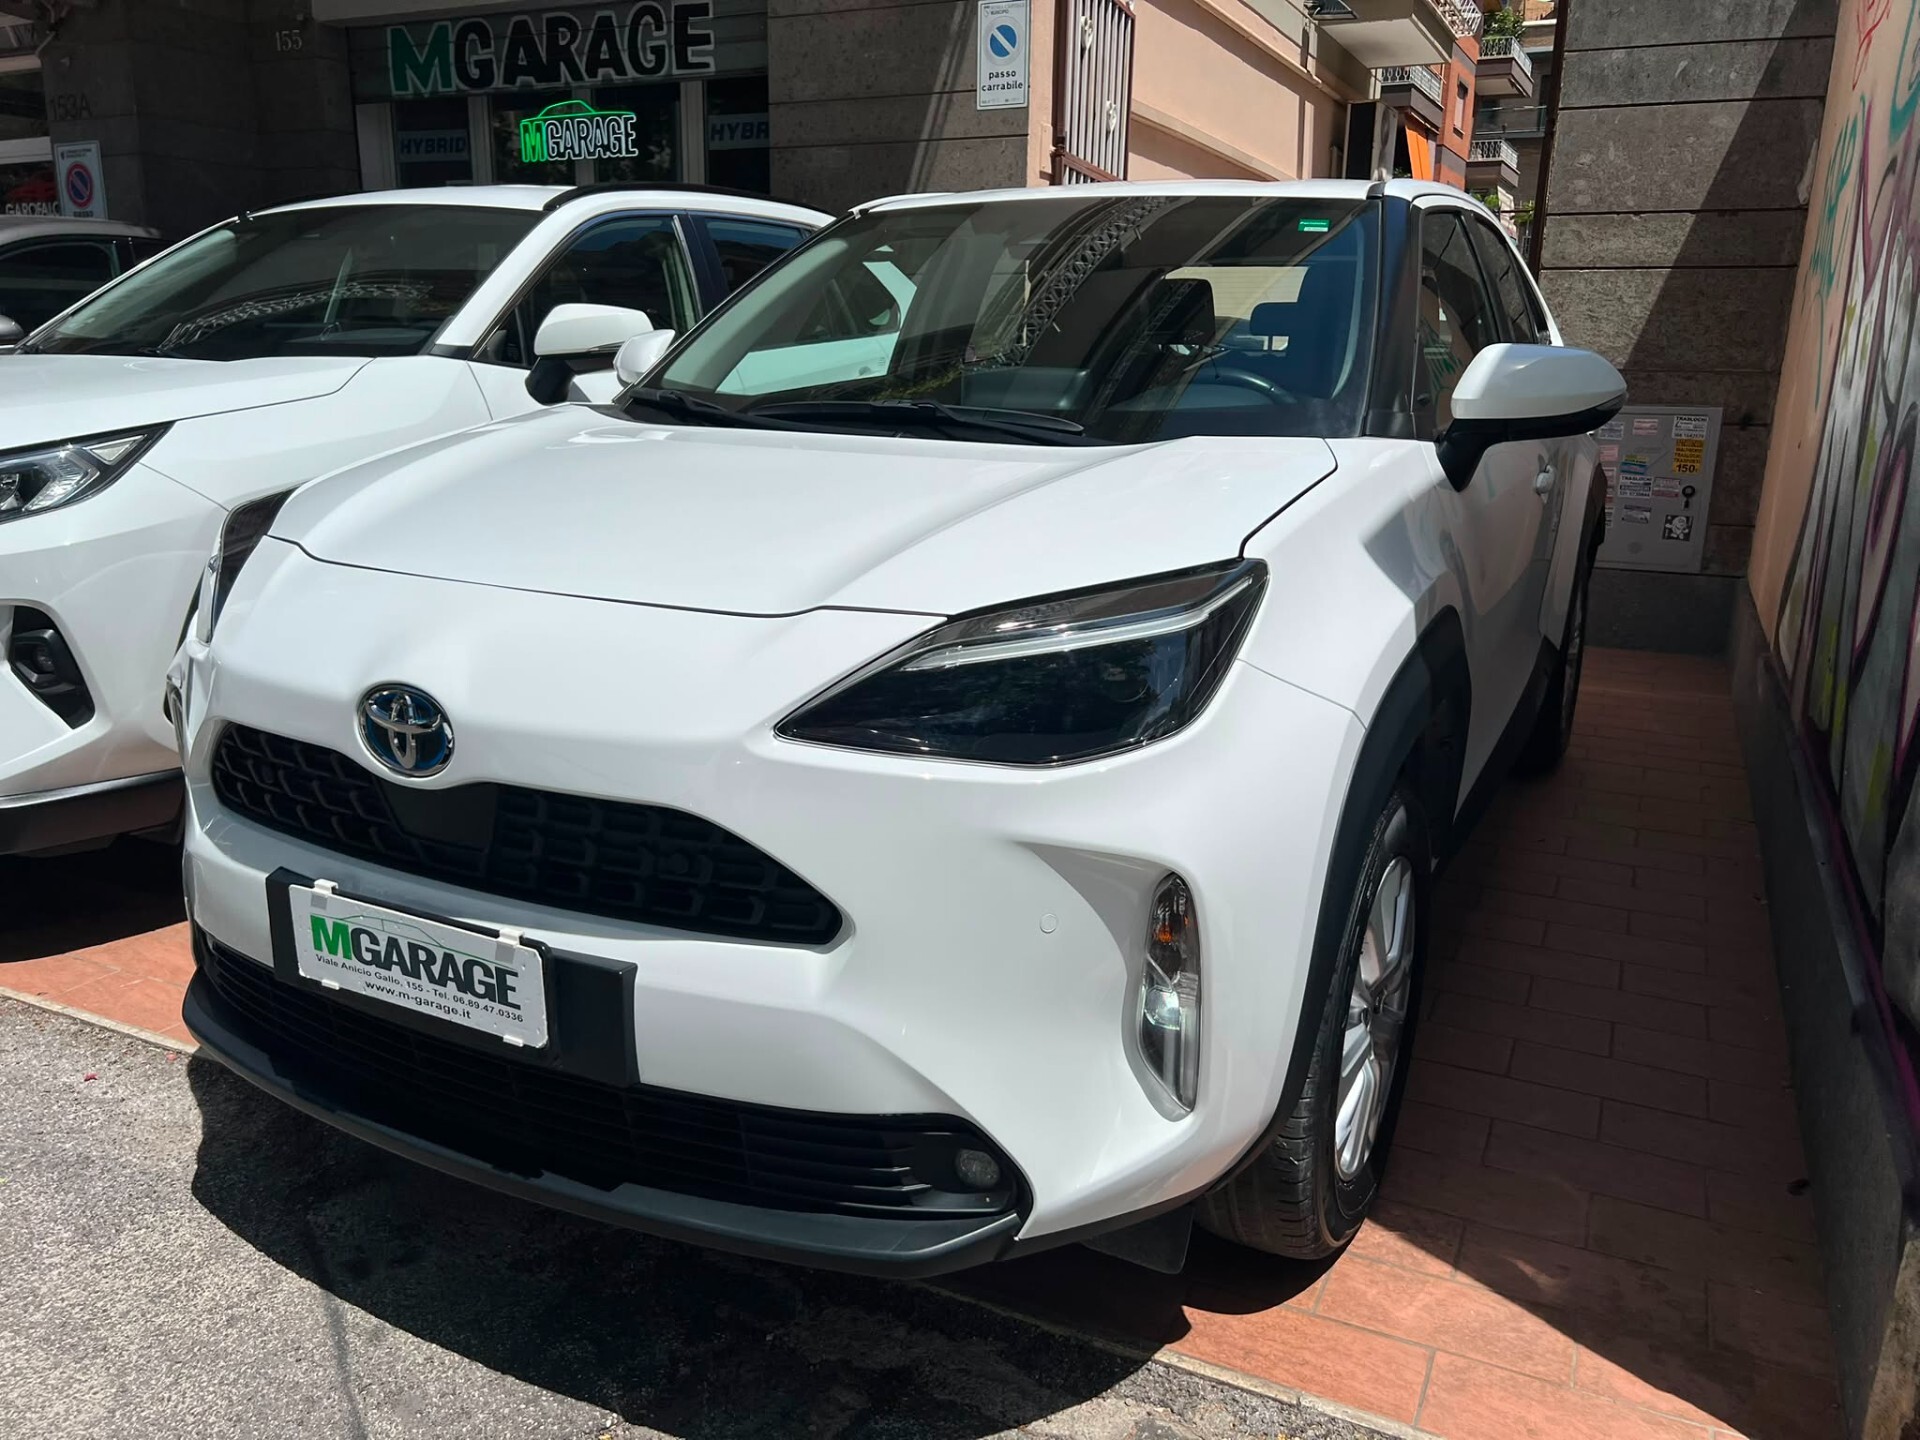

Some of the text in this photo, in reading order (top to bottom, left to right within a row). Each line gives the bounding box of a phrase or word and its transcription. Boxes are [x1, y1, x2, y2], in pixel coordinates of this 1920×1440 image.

[275, 29, 302, 51] 155
[387, 1, 715, 97] MGARAGE
[982, 81, 1023, 91] carrabile
[989, 71, 1016, 80] passo
[400, 136, 466, 154] HYBRID
[520, 115, 639, 162] MGARAGE
[311, 915, 521, 1010] MGARAGE
[316, 953, 338, 967] Viale
[341, 963, 371, 977] Anicio
[406, 981, 423, 992] 155
[453, 995, 523, 1022] 06.89.47.0336
[365, 981, 471, 1019] www.m-garage.it
